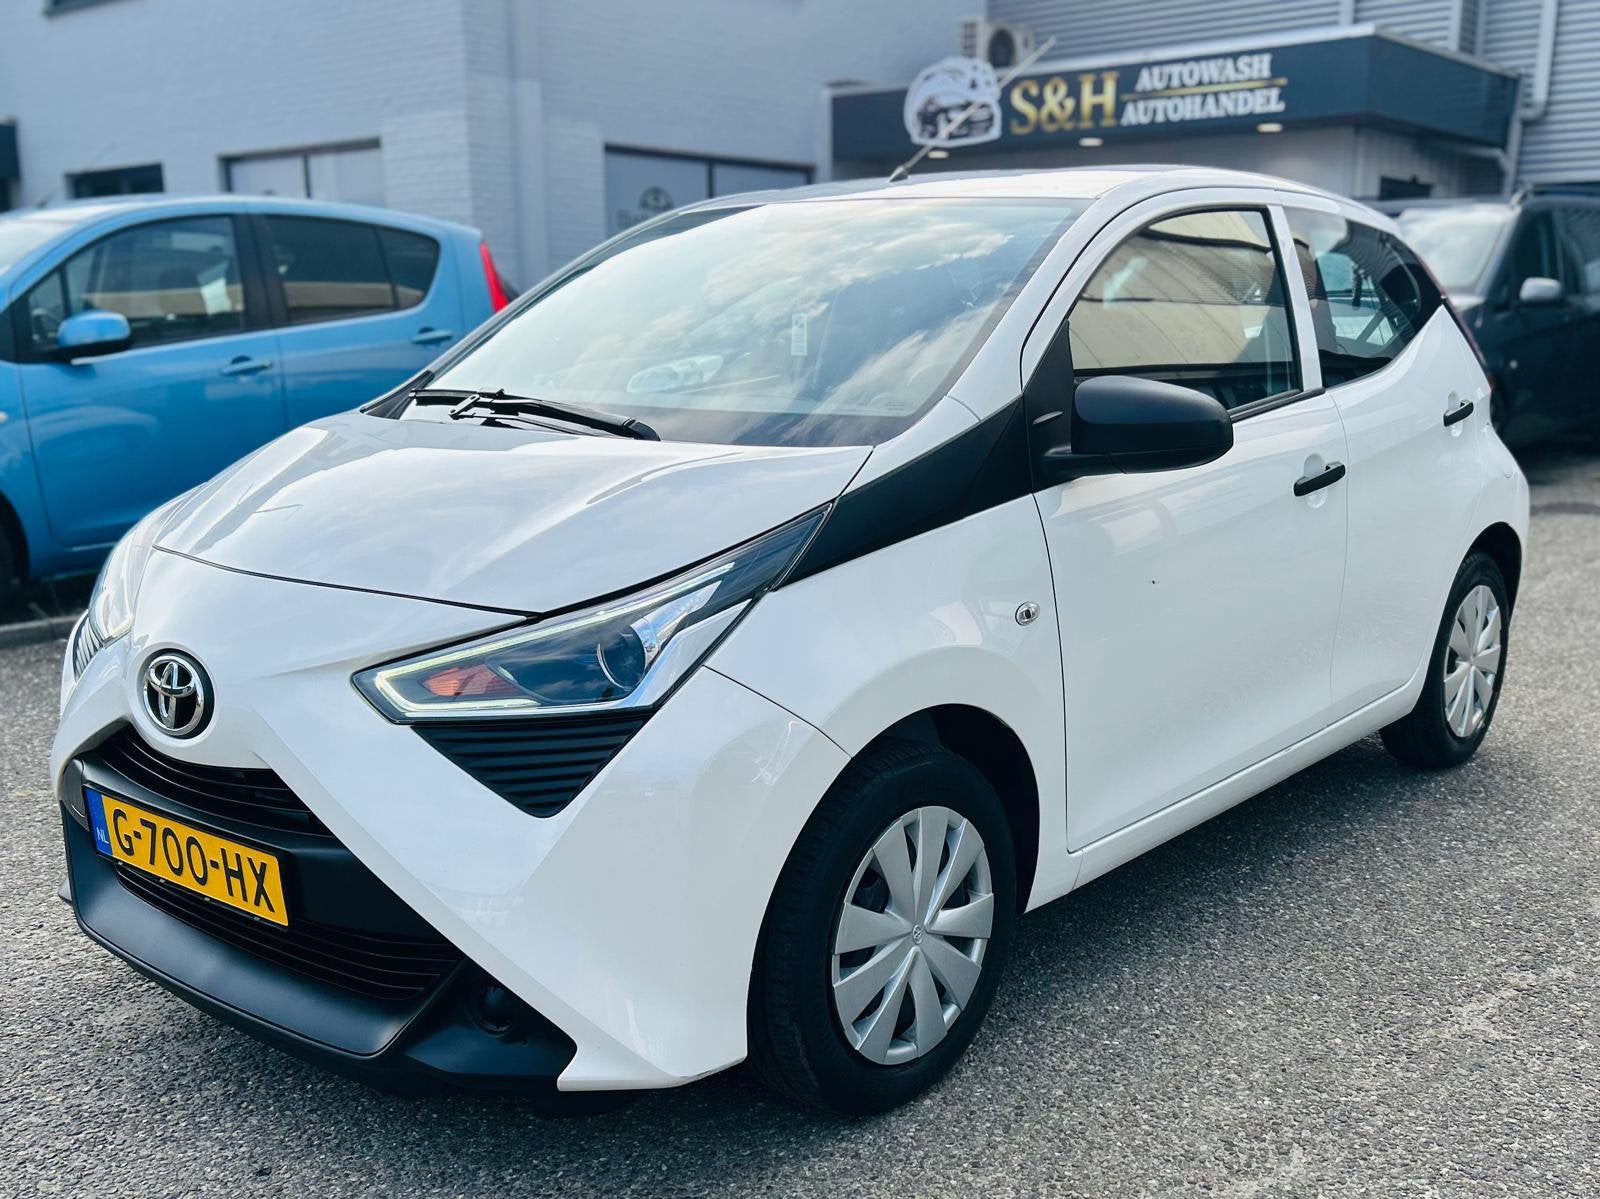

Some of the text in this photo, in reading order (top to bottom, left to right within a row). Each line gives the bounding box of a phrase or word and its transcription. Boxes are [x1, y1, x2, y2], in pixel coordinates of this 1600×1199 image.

[1136, 53, 1272, 91] AUTOWASH
[1010, 72, 1119, 134] S&H
[1121, 87, 1285, 125] AUTOHANDEL
[96, 828, 109, 844] NL
[113, 808, 275, 913] G-700-HX
